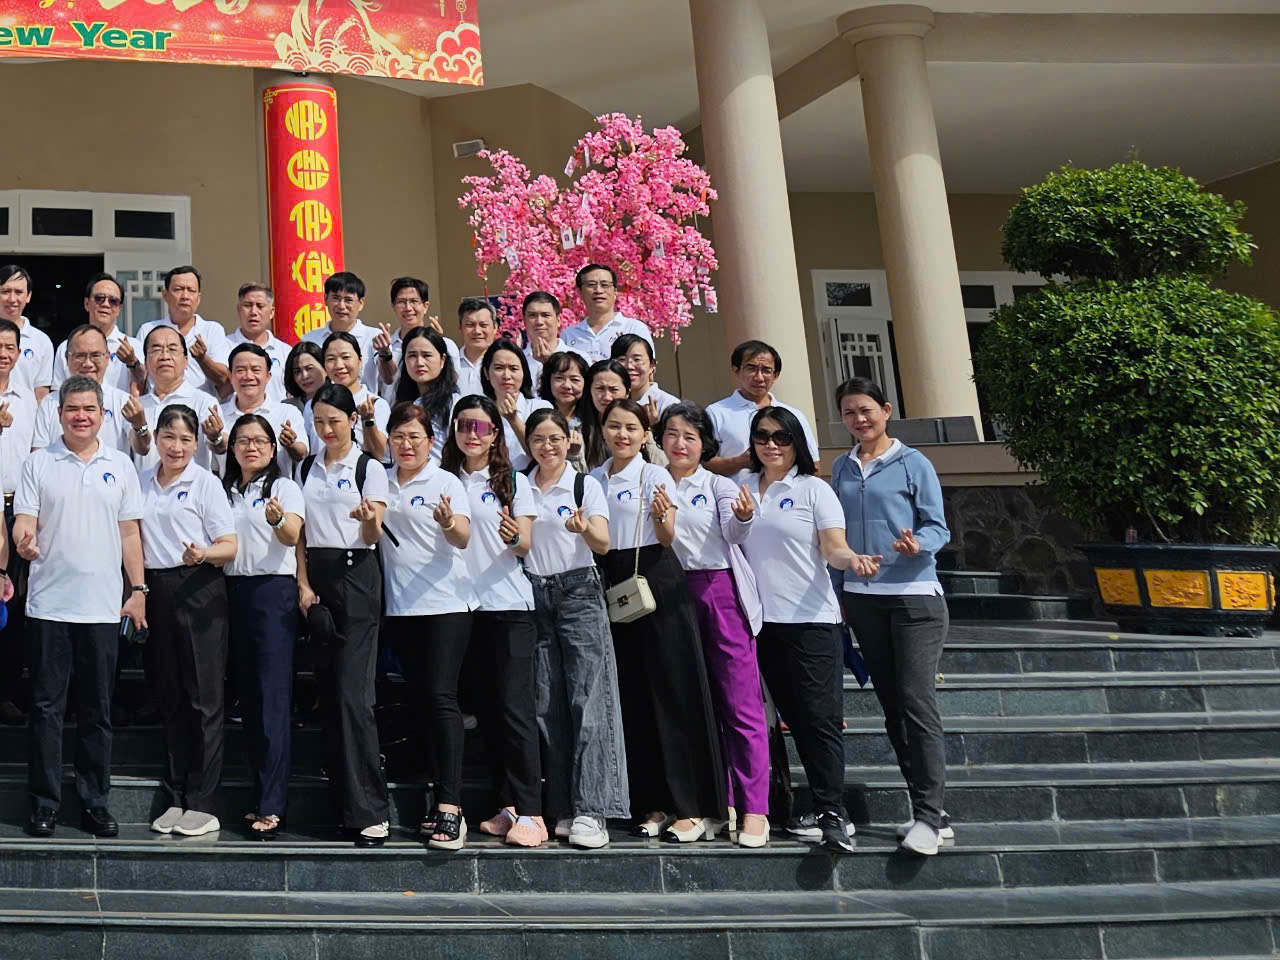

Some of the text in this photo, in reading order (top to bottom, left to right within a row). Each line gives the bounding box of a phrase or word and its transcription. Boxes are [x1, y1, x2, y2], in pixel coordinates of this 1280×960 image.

[72, 21, 175, 51] Year
[285, 100, 327, 140] NAY
[289, 200, 332, 241] TAY
